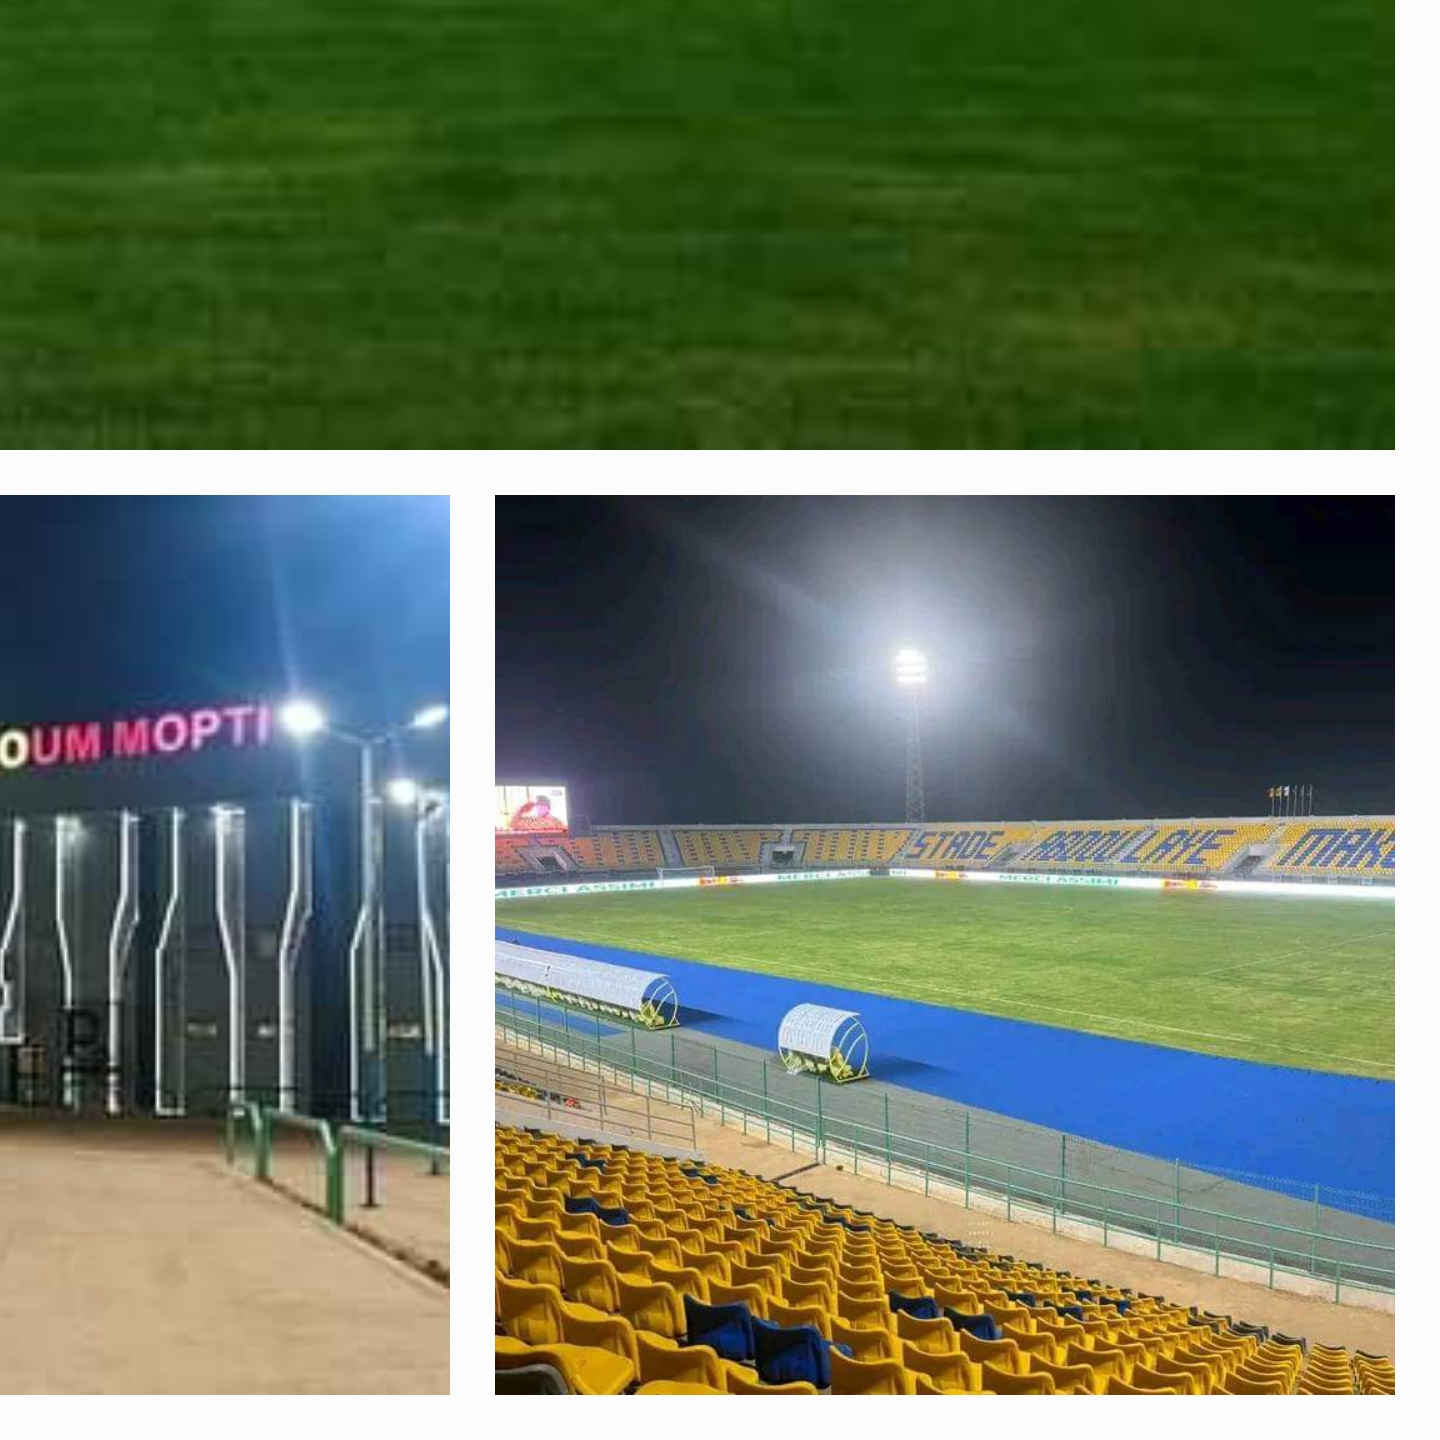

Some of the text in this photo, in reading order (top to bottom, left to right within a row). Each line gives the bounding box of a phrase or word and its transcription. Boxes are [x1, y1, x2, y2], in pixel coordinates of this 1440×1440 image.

[114, 702, 272, 756] MOPTI
[904, 830, 1005, 860] STADE
[1274, 828, 1395, 869] MAK
